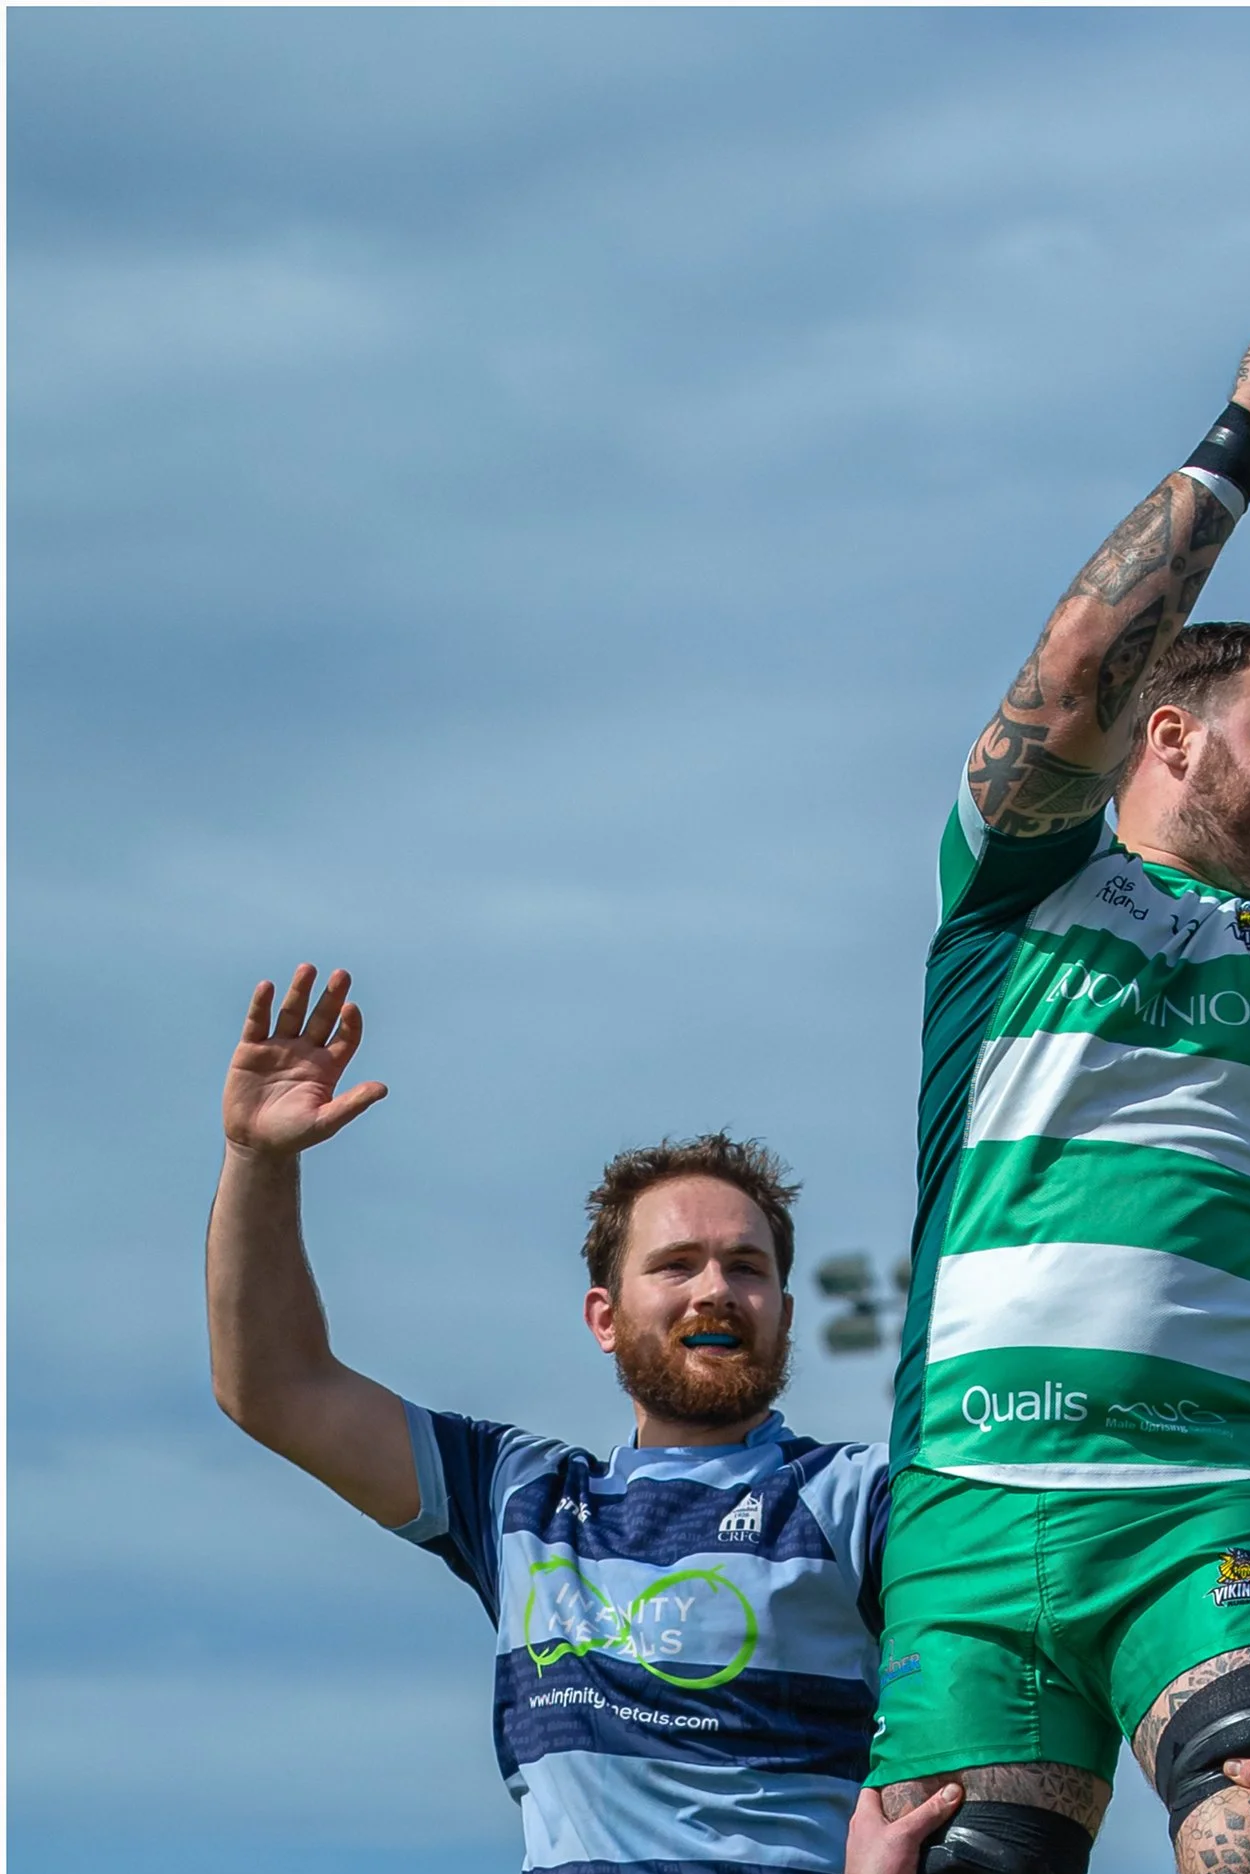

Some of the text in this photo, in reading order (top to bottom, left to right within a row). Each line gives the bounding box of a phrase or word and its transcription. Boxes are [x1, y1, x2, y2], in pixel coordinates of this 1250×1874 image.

[962, 1380, 1088, 1433] Qualis
[1140, 1420, 1188, 1434] Uprising
[717, 1530, 760, 1544] CRFC
